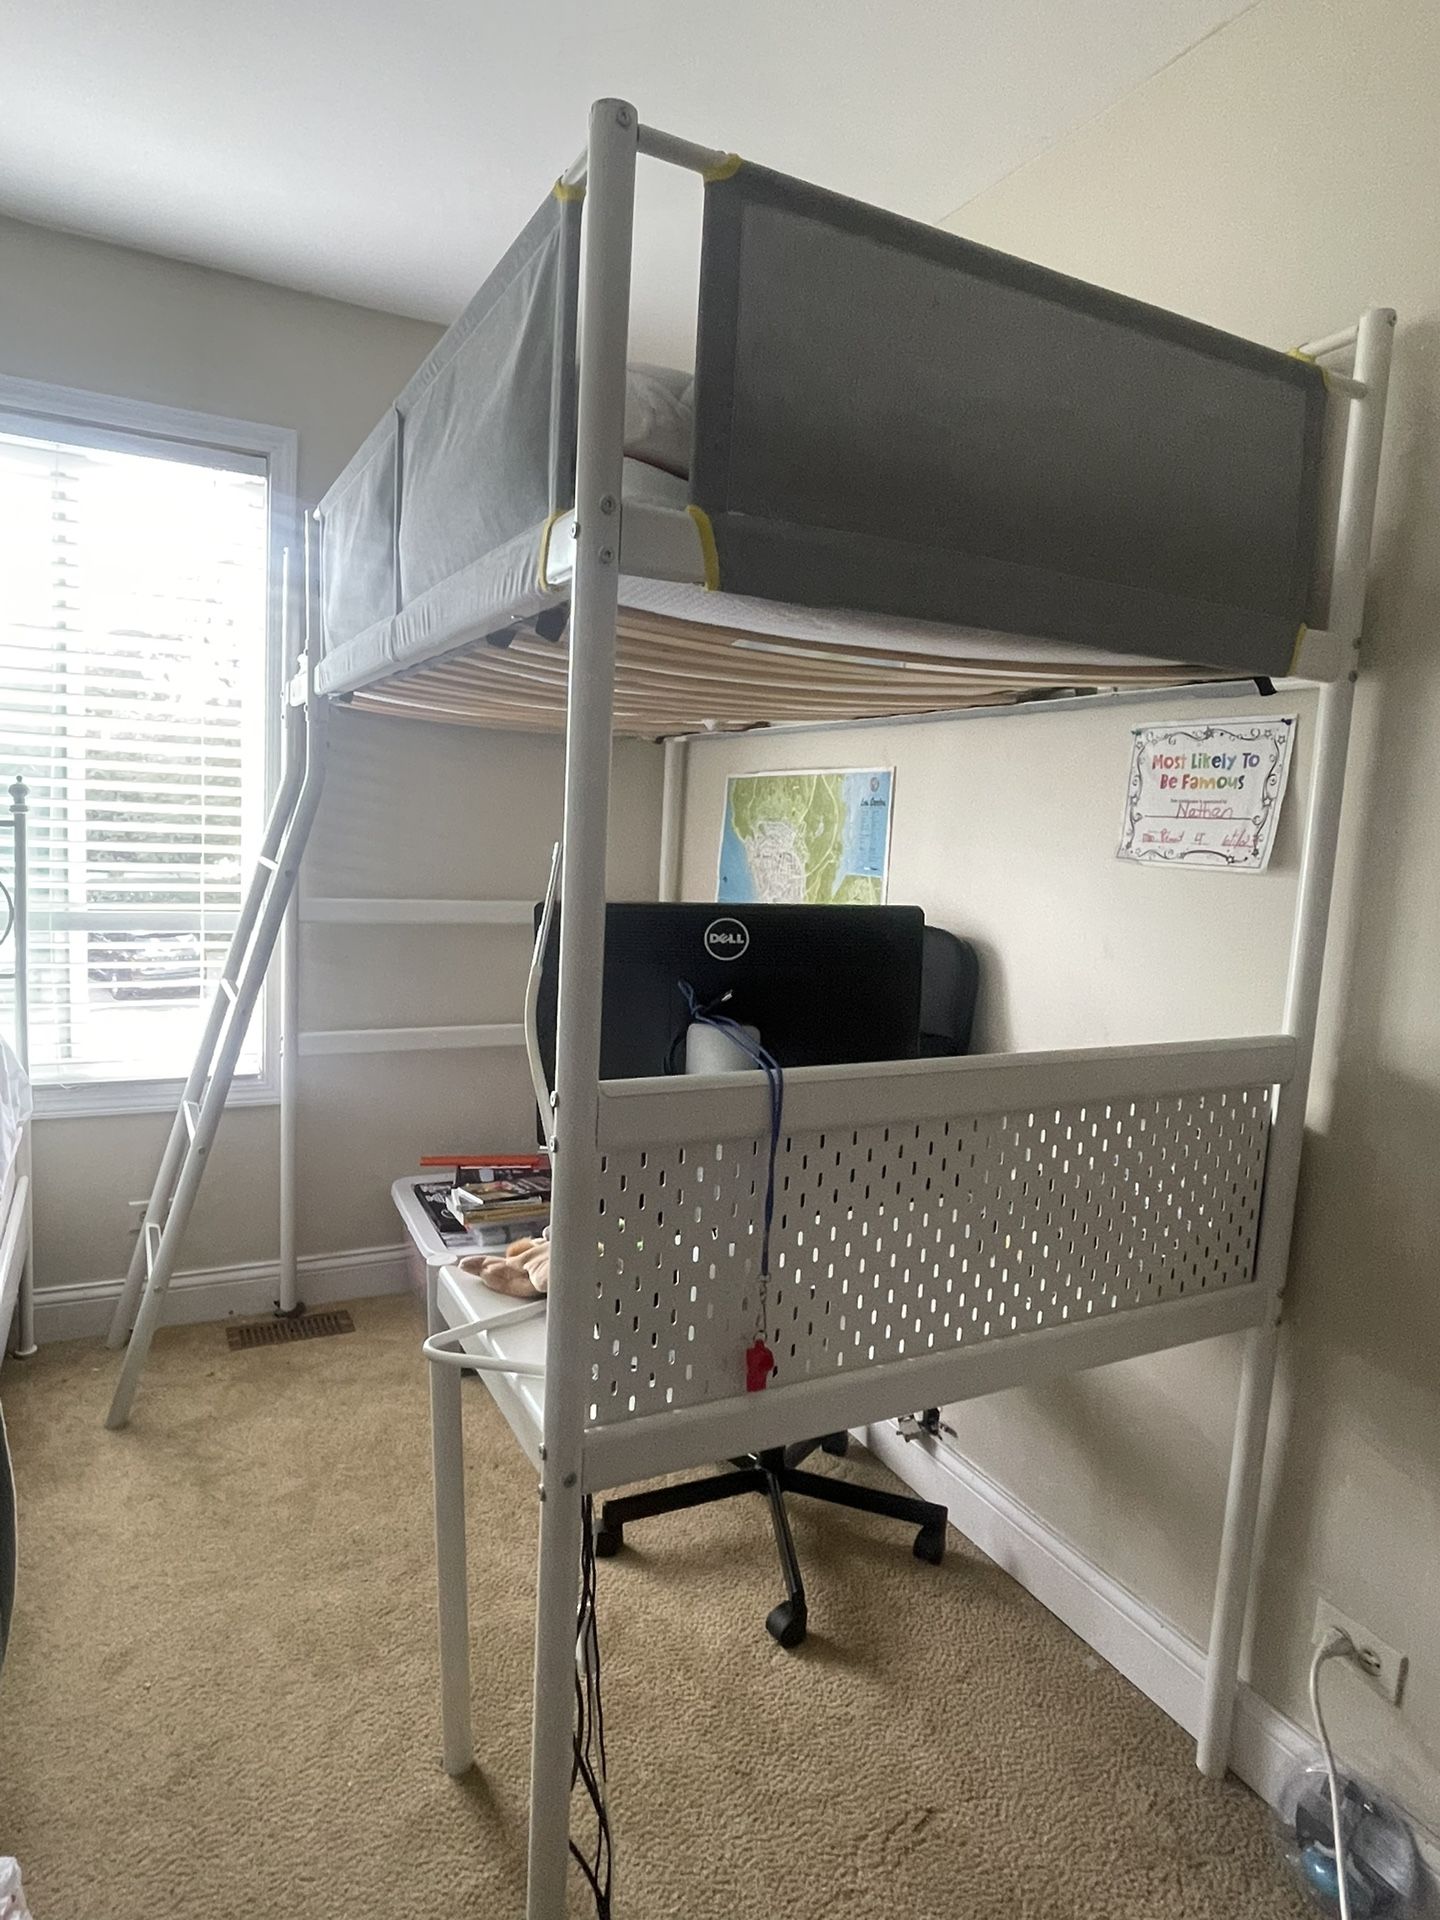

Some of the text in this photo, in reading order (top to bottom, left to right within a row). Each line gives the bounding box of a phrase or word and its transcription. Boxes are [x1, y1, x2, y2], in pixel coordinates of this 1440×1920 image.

[1152, 754, 1187, 770] Most
[1191, 753, 1237, 771] Likely
[1160, 774, 1245, 789] Be Famous
[709, 933, 745, 944] DELL
